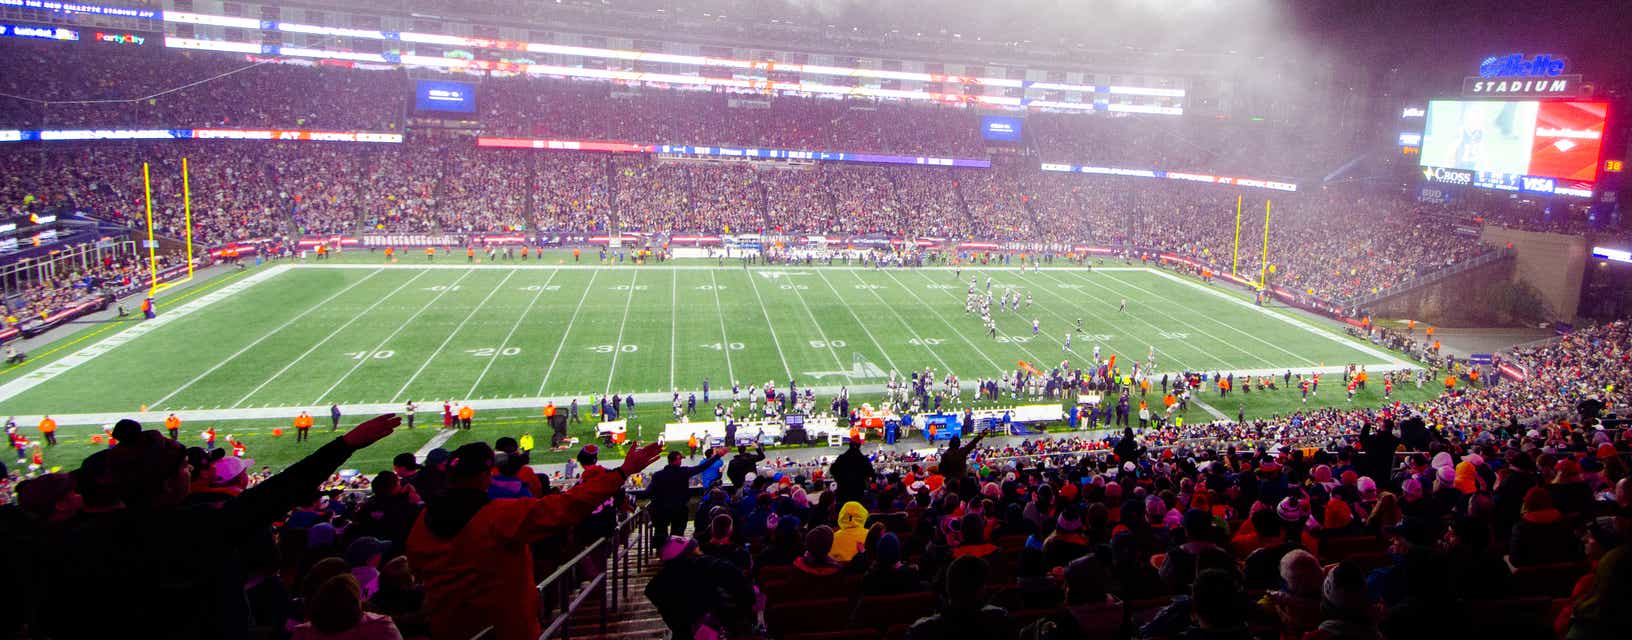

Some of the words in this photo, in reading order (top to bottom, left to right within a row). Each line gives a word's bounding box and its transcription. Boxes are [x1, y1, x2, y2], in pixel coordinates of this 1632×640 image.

[103, 8, 137, 16] STADIUM
[1473, 80, 1567, 92] STADIUM
[1607, 160, 1621, 170] 38
[1522, 177, 1553, 192] VISA
[809, 339, 847, 348] 50
[908, 337, 941, 345] 40
[594, 344, 638, 353] 30
[708, 342, 745, 351] 40
[352, 350, 395, 360] 10
[471, 347, 522, 357] 20
